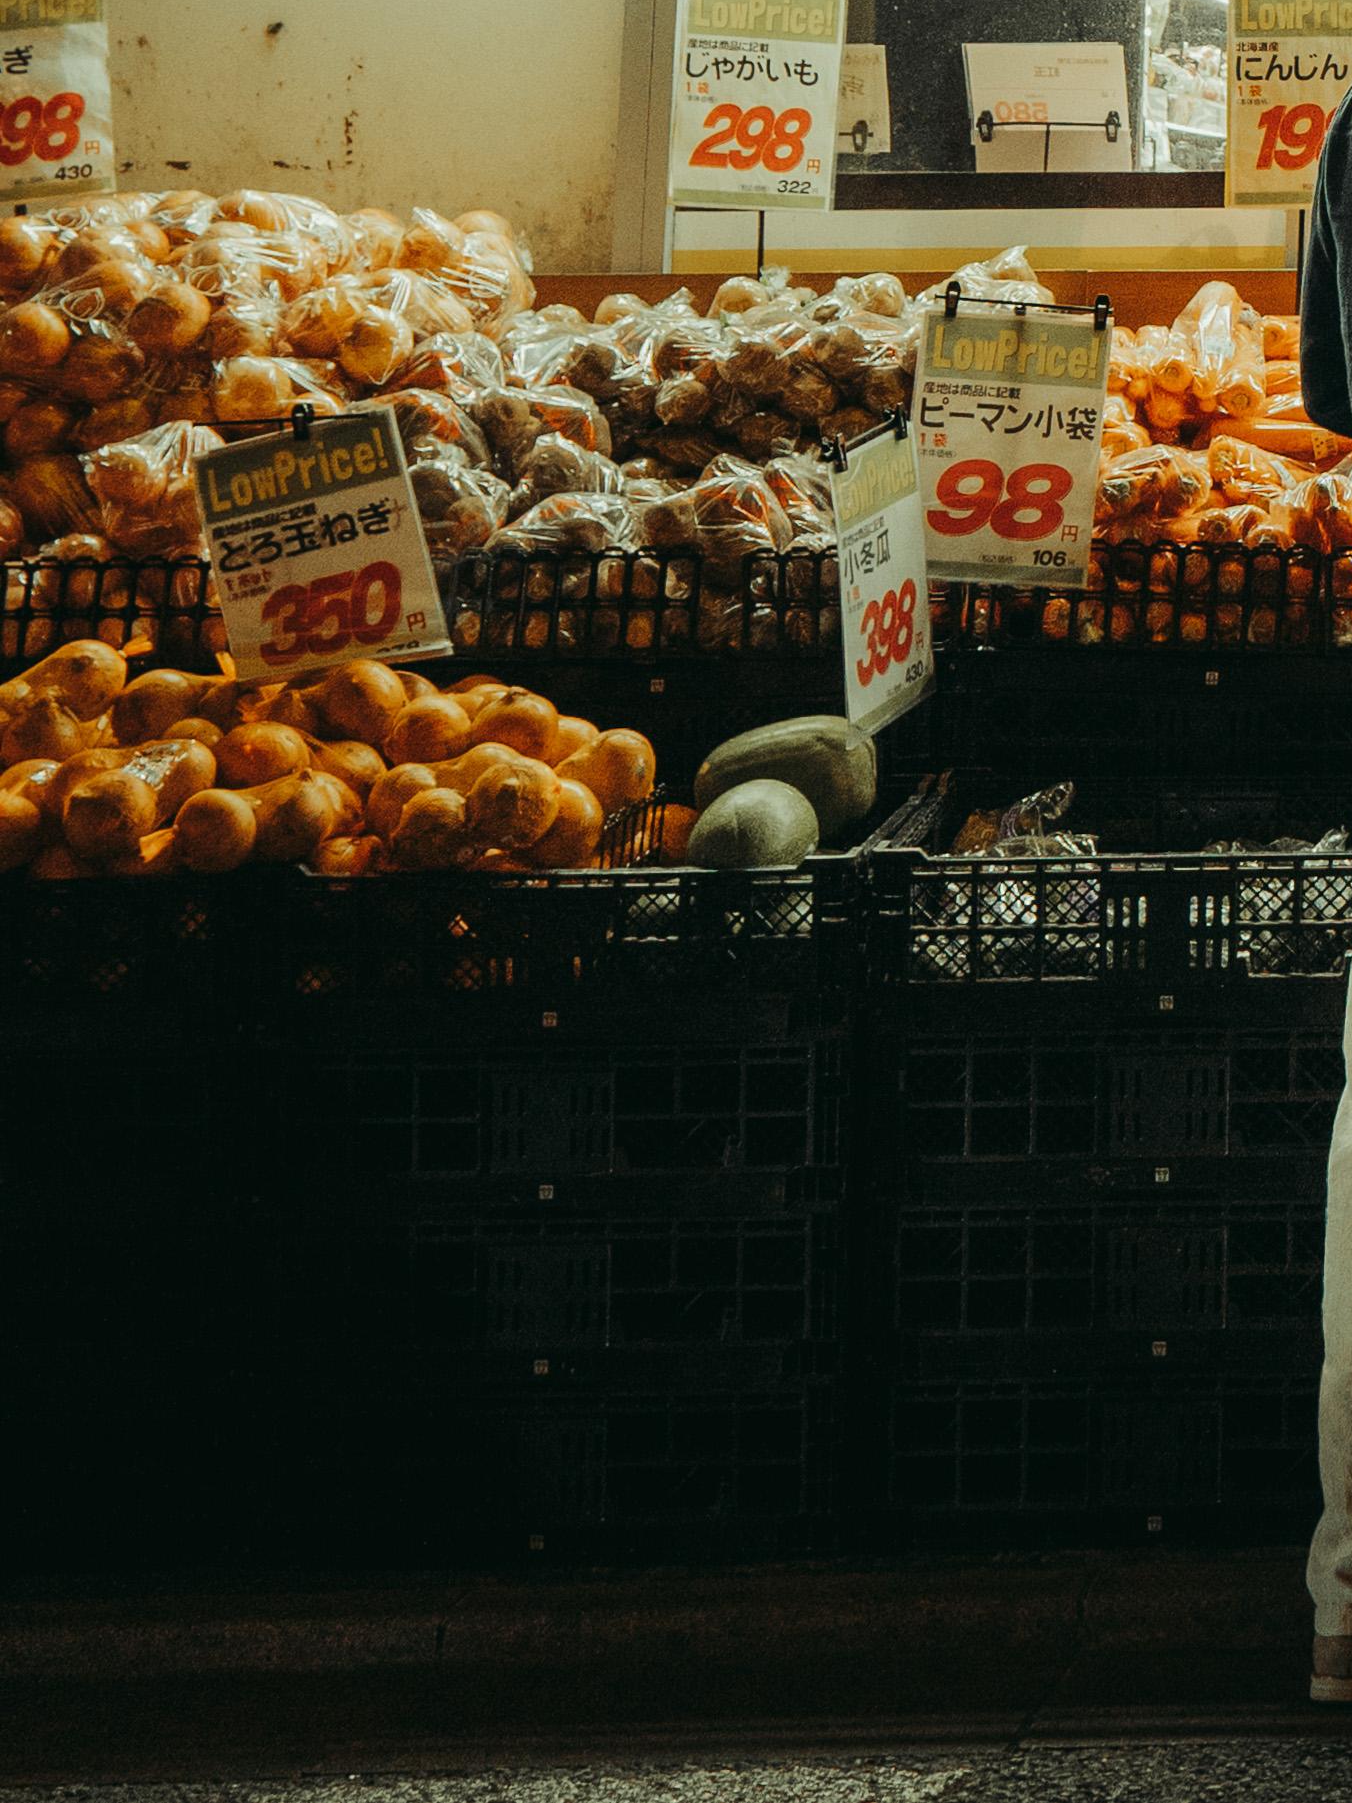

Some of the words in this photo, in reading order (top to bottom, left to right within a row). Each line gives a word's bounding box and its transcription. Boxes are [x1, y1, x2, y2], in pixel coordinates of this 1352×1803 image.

[0, 44, 33, 75] ぎ
[685, 52, 819, 86] じゃがいも
[1235, 41, 1280, 53] 北海道産
[1235, 53, 1349, 82] にんじん
[0, 92, 85, 166] 98
[688, 103, 813, 173] 298
[806, 159, 821, 174] 円
[1255, 102, 1338, 171] 19
[54, 163, 93, 181] 430
[776, 180, 812, 194] 322
[932, 324, 1100, 380] LowPrice!
[920, 397, 1098, 441] ピーマン小袋
[922, 382, 1021, 400] 産地は商品に記載
[207, 427, 390, 513] LowPrice!
[926, 458, 1075, 543] 98
[1060, 524, 1079, 543] 円
[218, 496, 392, 574] とろ玉ねぎ
[844, 528, 891, 584] 小冬瓜
[1032, 548, 1068, 567] 106
[259, 560, 402, 667] 350
[855, 578, 918, 688] 398
